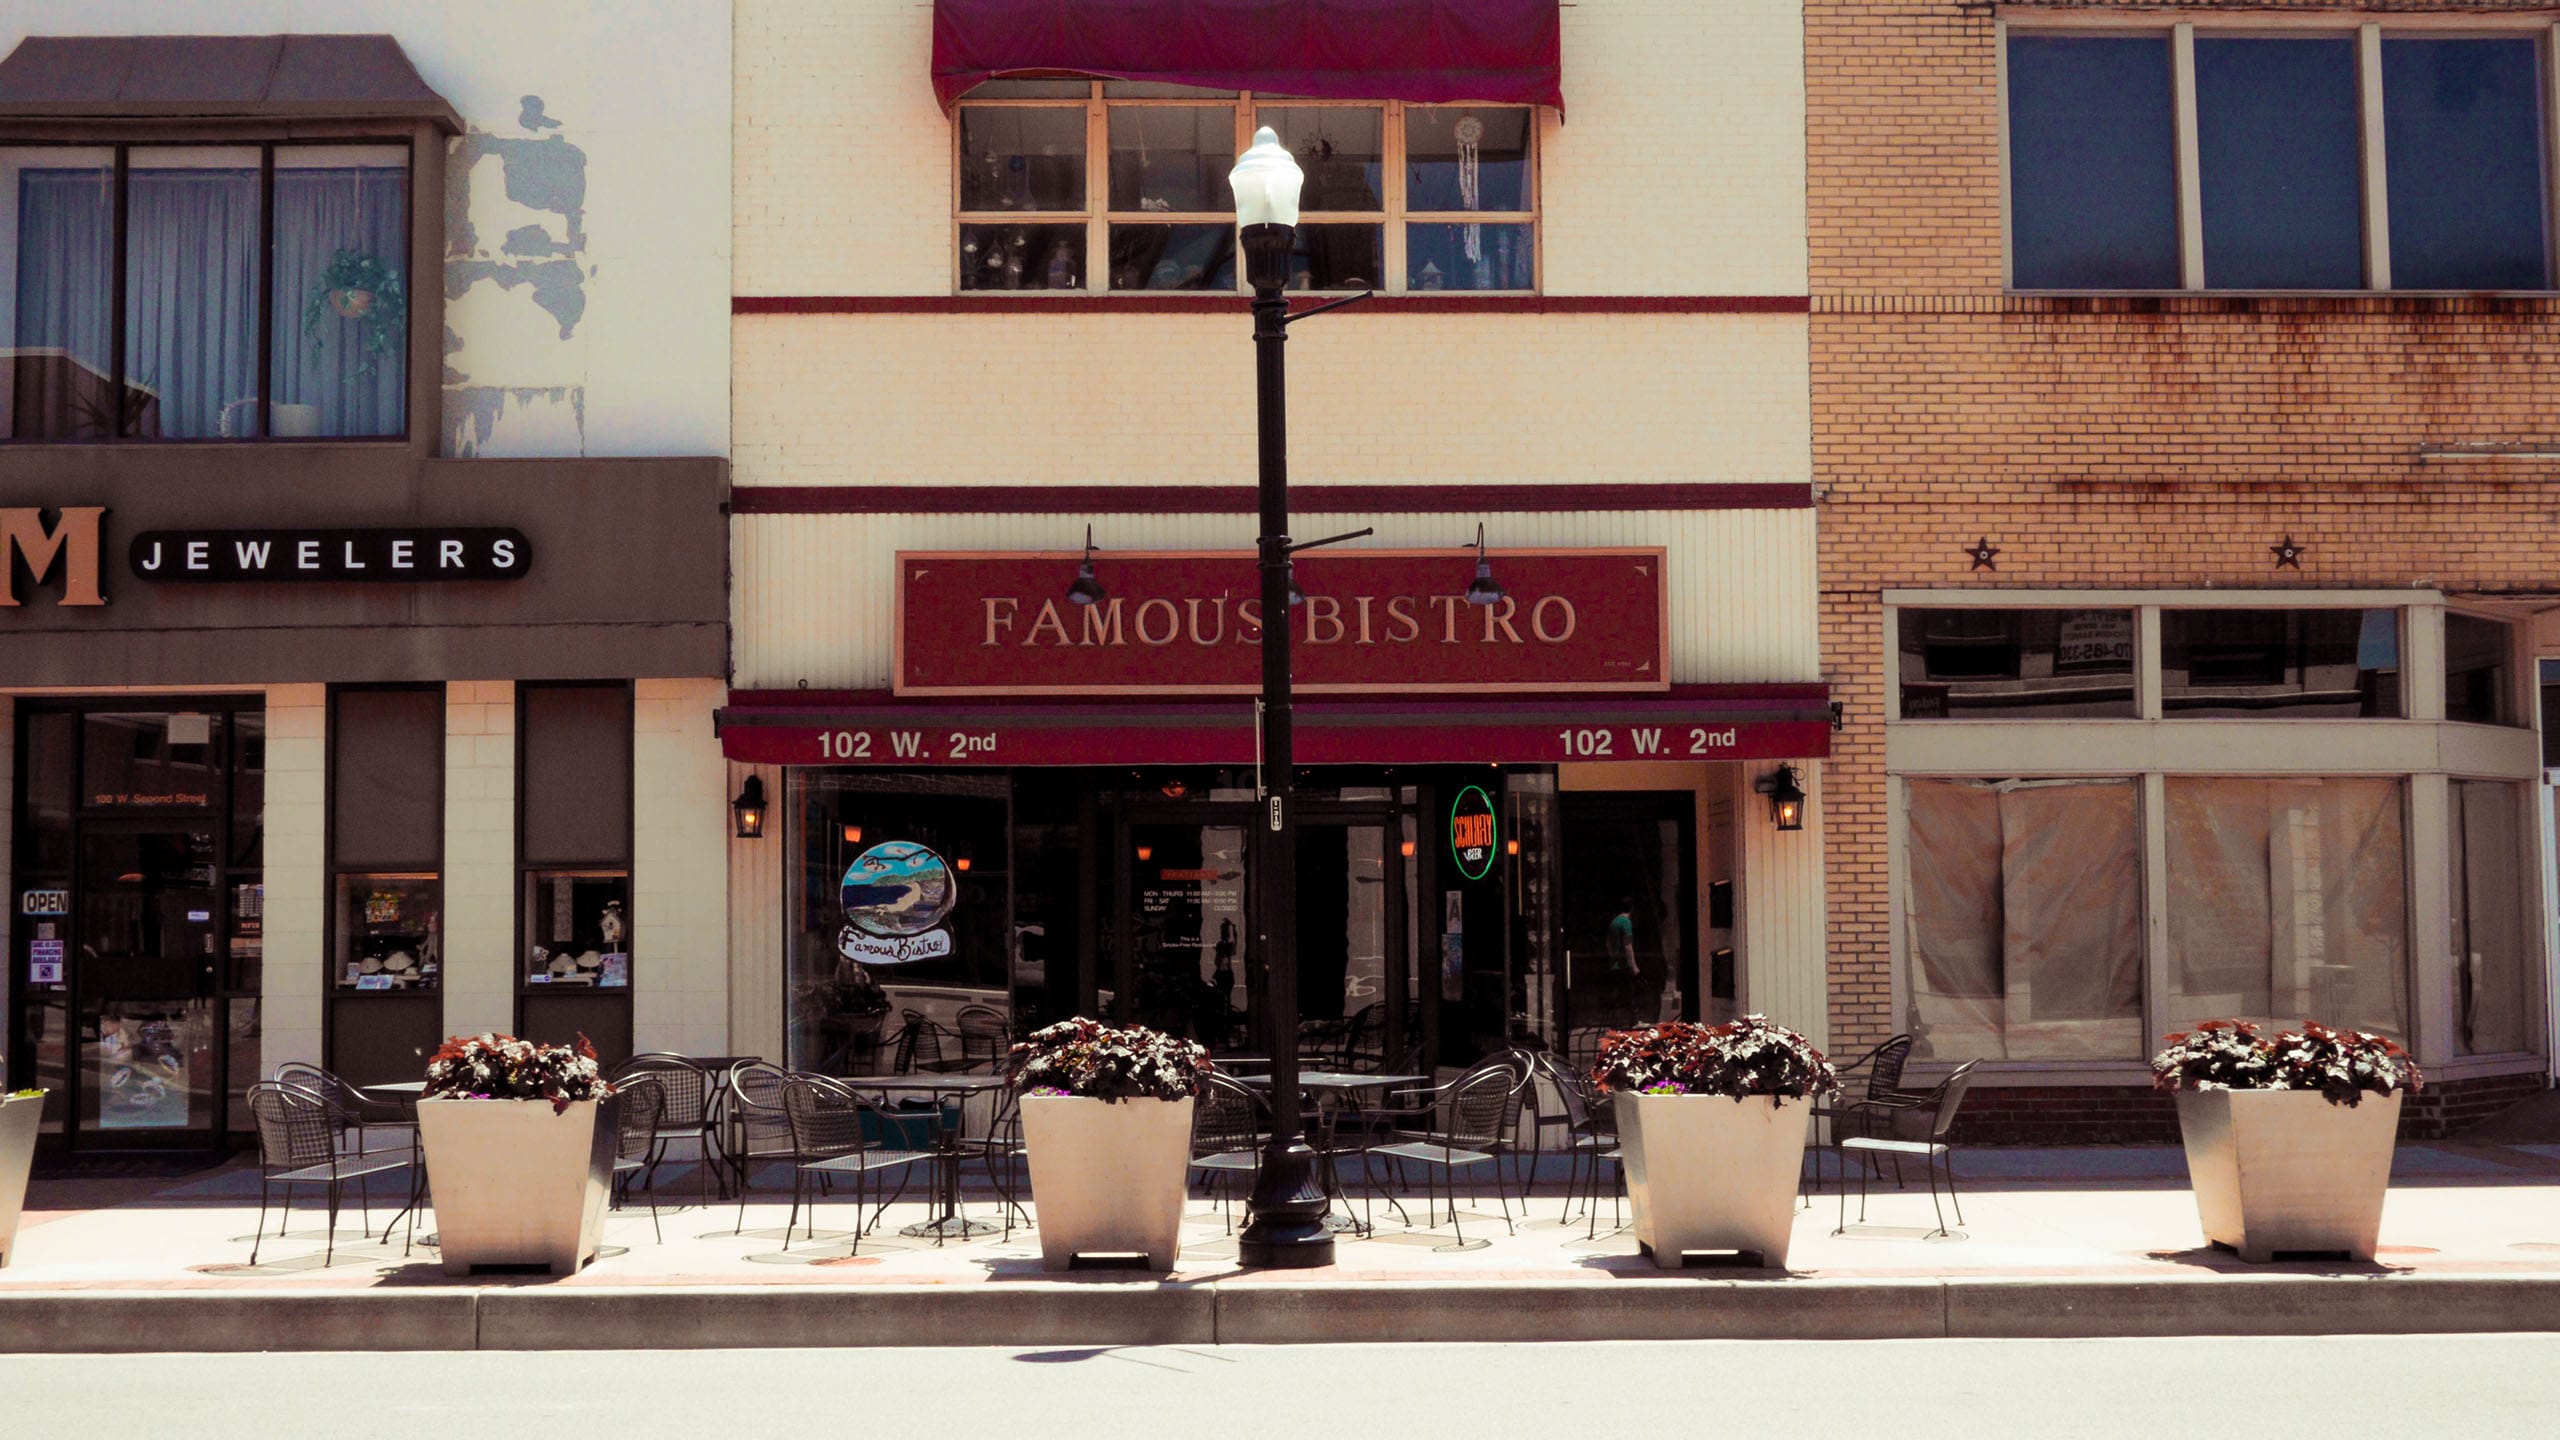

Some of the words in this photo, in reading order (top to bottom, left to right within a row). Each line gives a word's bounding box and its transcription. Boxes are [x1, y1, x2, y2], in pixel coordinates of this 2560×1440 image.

[142, 539, 518, 570] JEWELERS
[980, 597, 1262, 647] FAMOUS
[1303, 595, 1577, 644] BISTRO
[817, 732, 871, 758] 102
[891, 732, 930, 758] W.
[949, 732, 997, 759] 2nd
[1559, 729, 1613, 756] 102
[1631, 729, 1670, 755] W.
[1690, 728, 1736, 754] 2nd
[133, 794, 173, 804] Second
[176, 793, 207, 804] Street
[1464, 847, 1483, 861] BEER
[26, 893, 67, 912] OPEN
[1448, 899, 1461, 921] A
[840, 925, 896, 957] Famous
